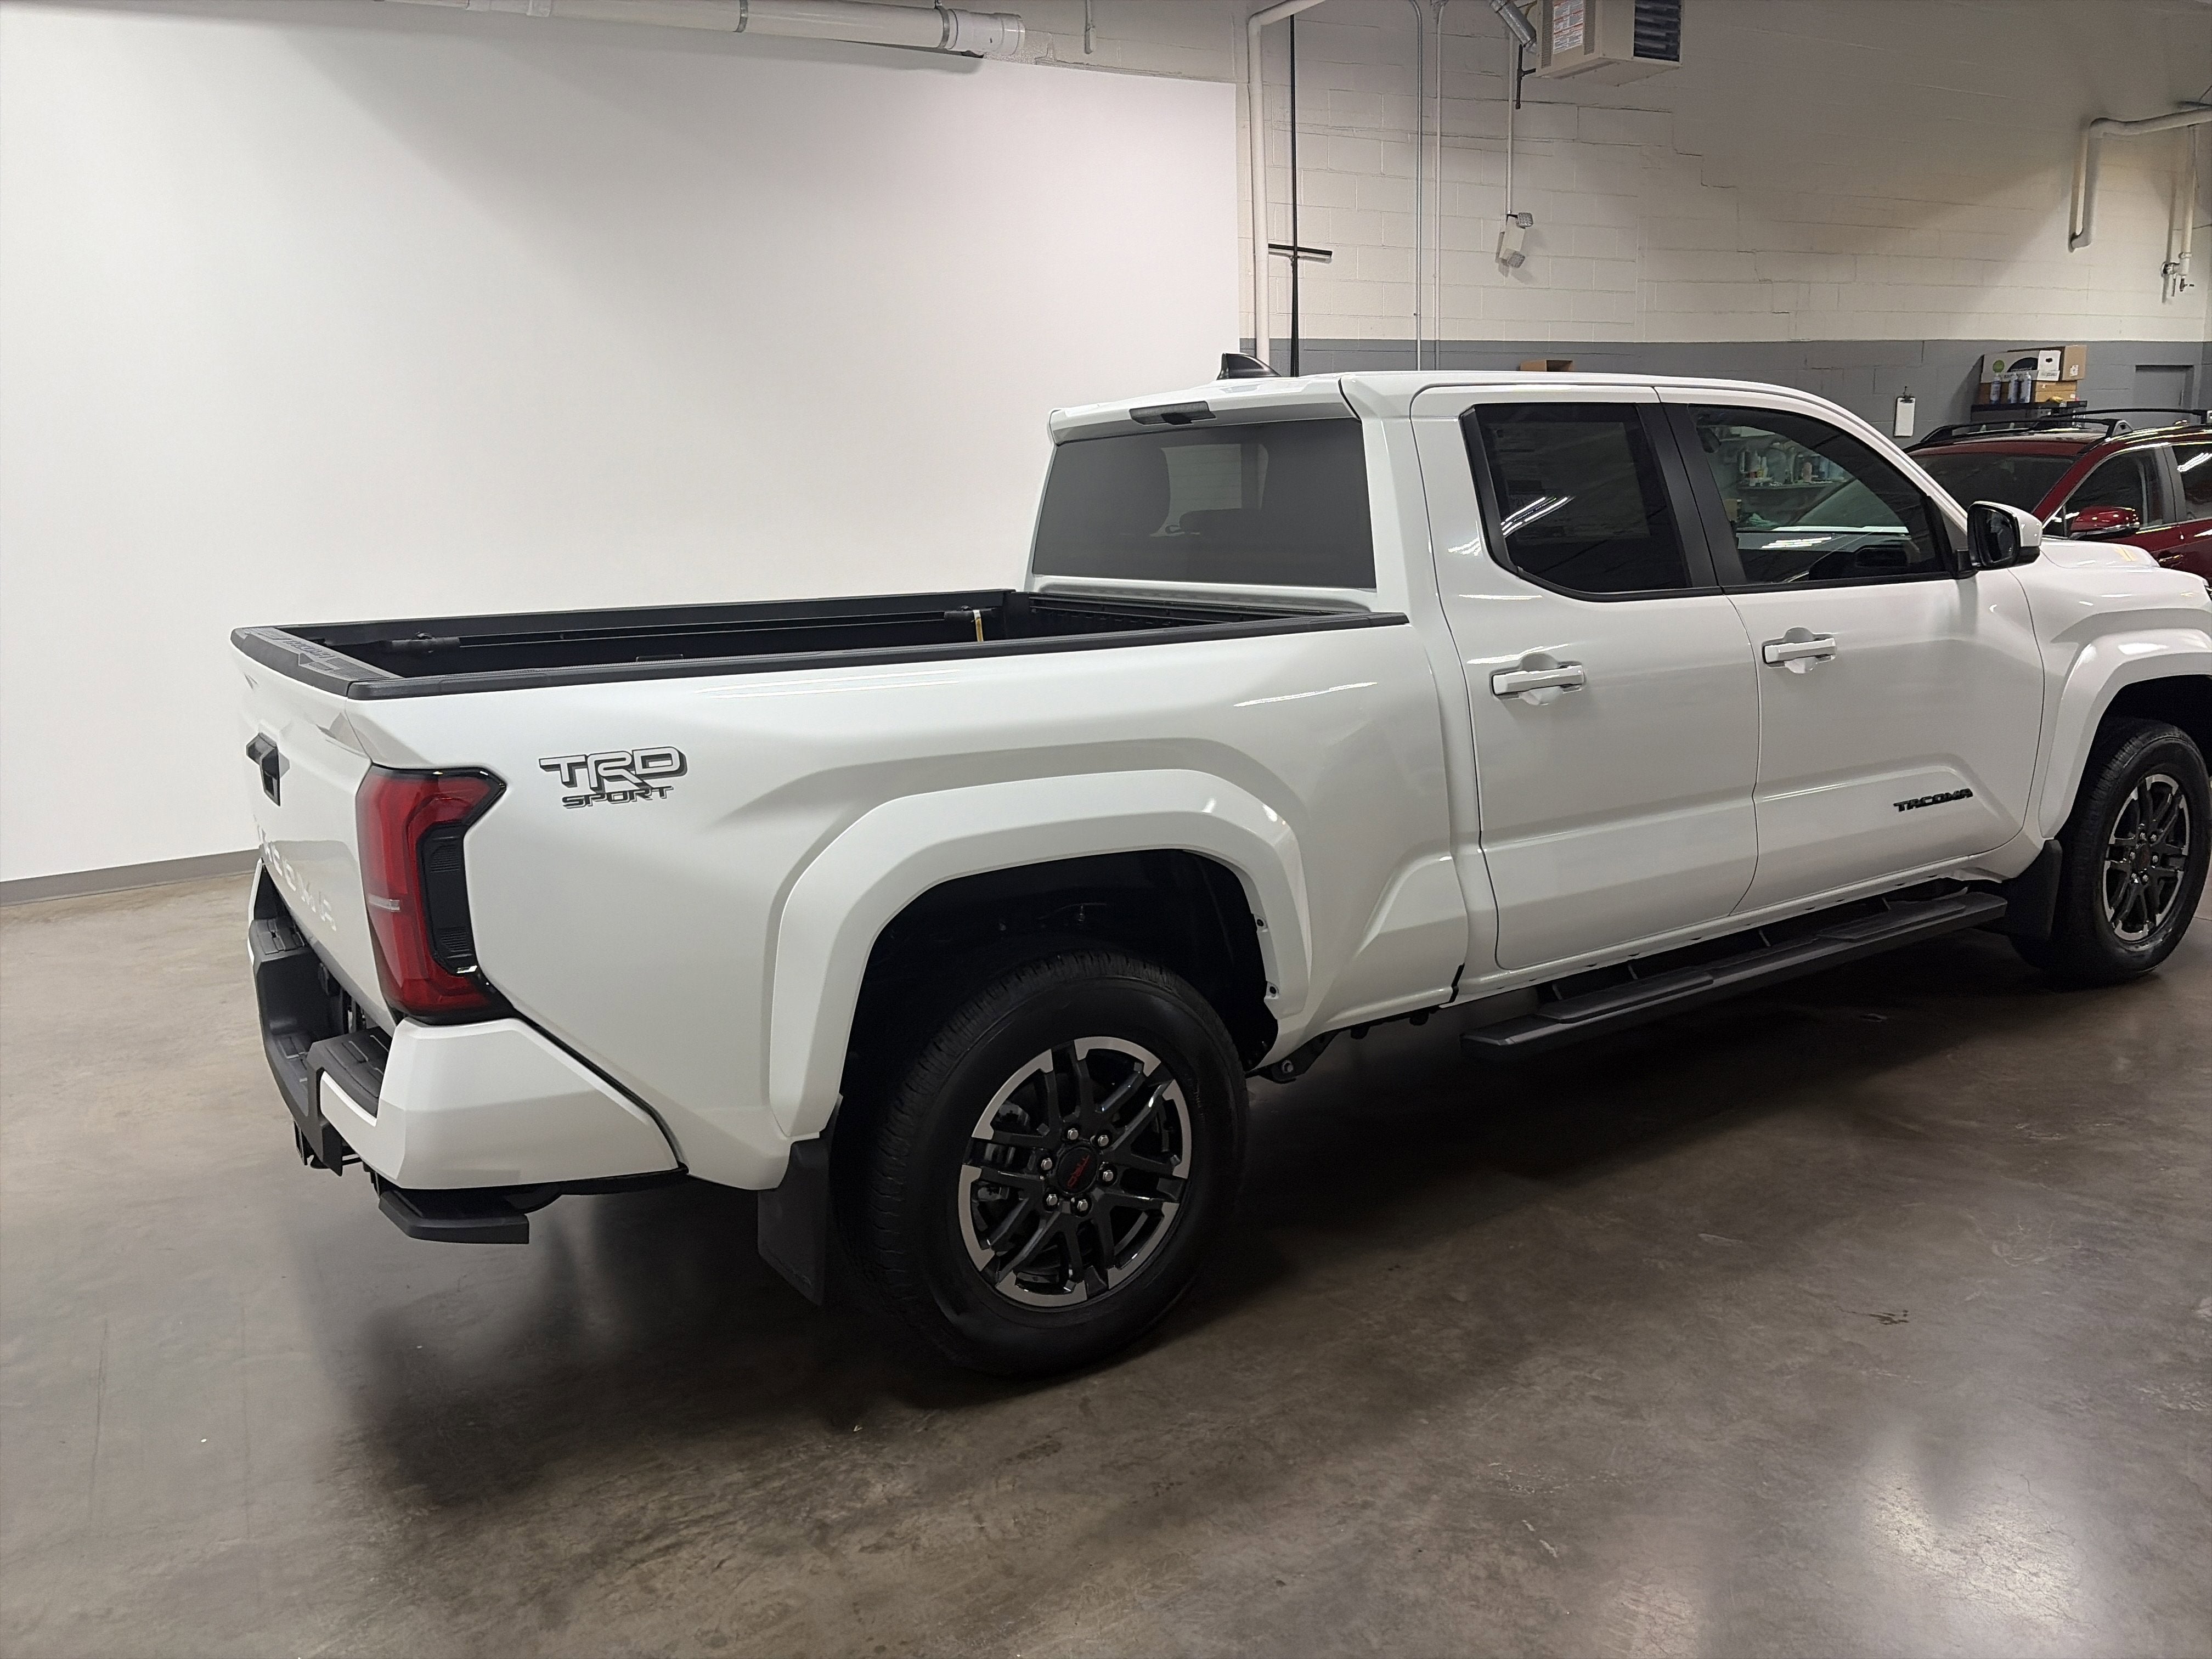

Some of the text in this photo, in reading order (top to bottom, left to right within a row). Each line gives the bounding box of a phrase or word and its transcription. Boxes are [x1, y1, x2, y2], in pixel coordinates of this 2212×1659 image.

[538, 746, 688, 793] TRD
[562, 785, 674, 809] SPORT
[1893, 788, 1973, 812] TACOMA
